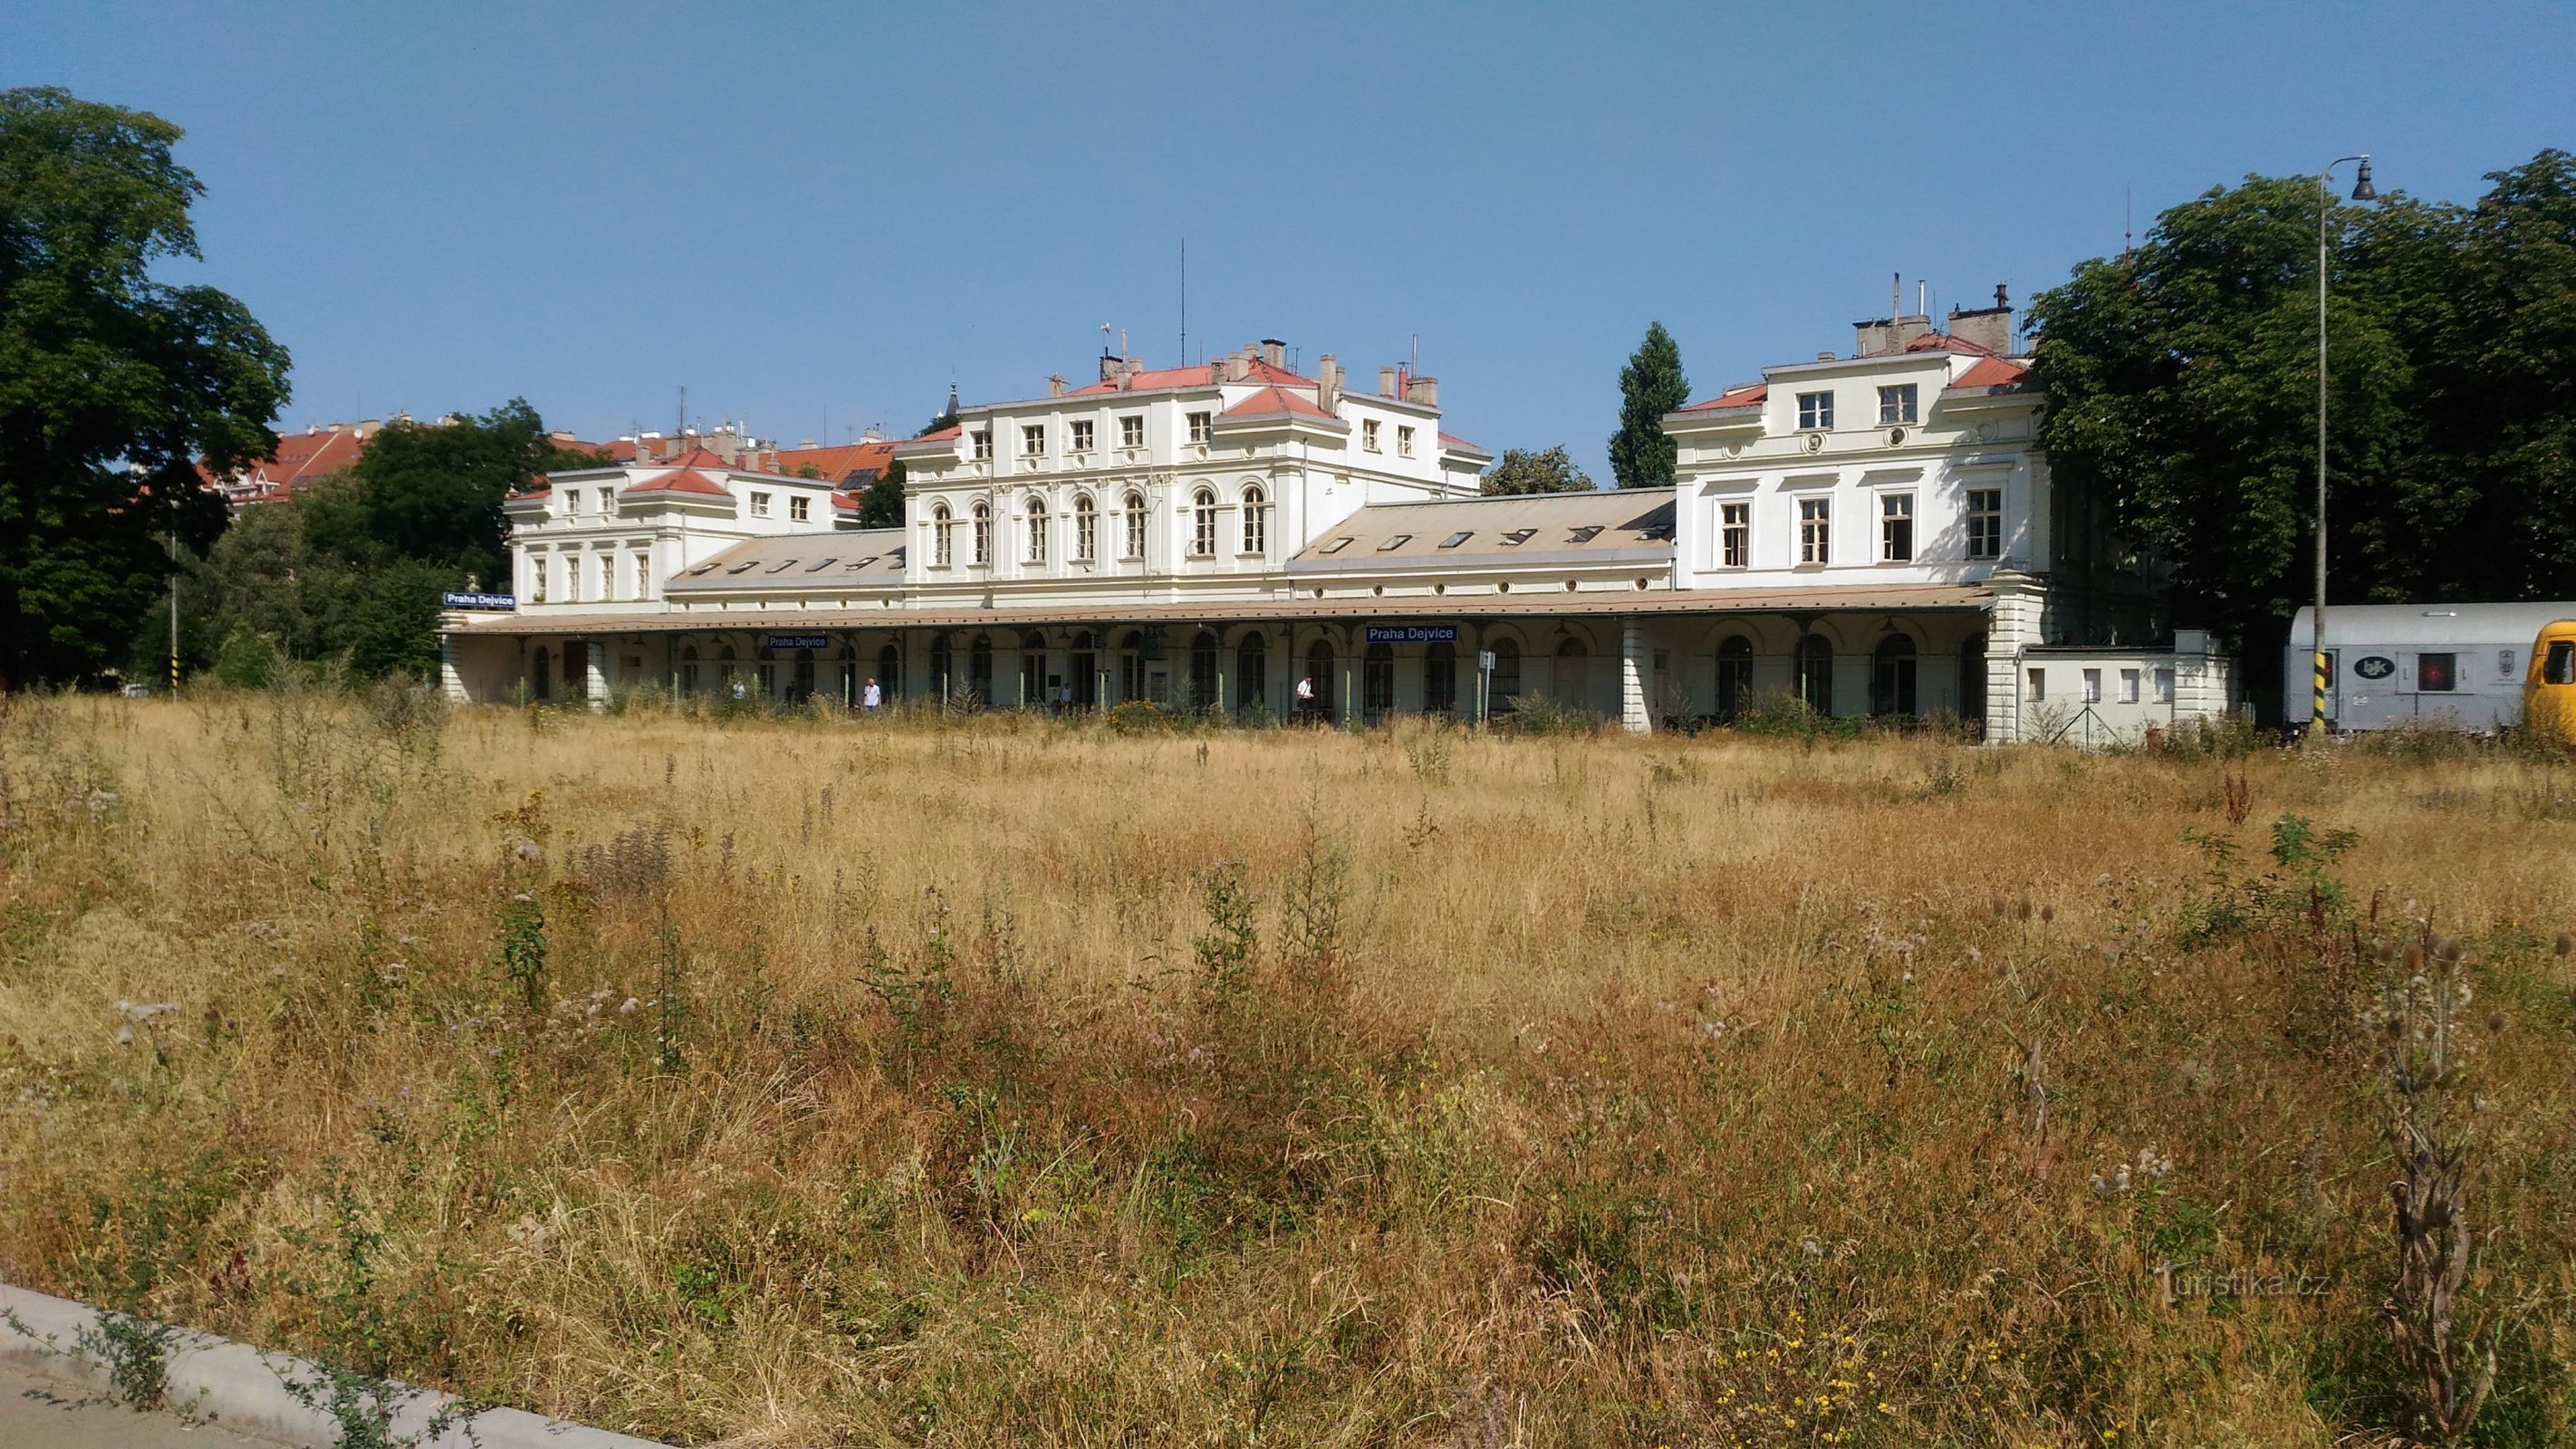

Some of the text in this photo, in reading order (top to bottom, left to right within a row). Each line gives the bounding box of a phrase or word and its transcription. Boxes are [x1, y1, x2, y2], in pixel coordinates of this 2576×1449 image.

[447, 594, 514, 606] Praha Dejvice
[1370, 628, 1454, 641] Praha Dejvice
[770, 637, 826, 648] Praha Dejvice
